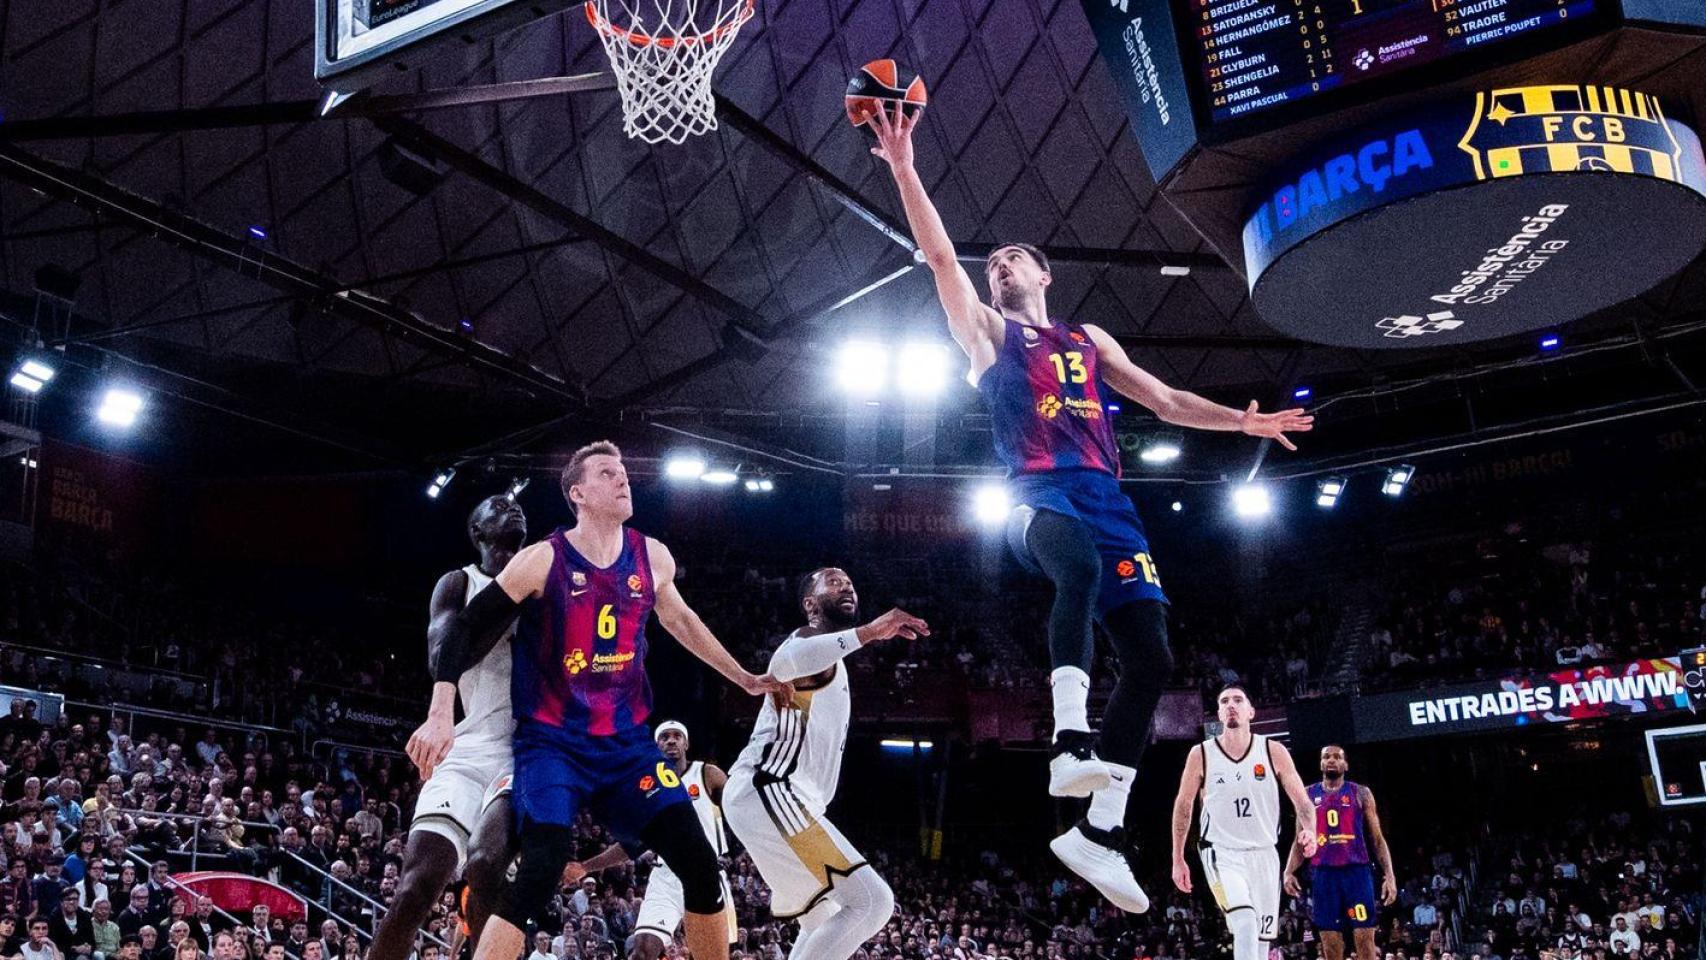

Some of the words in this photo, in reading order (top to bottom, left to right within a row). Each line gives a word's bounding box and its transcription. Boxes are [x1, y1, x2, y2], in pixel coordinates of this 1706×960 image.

[1213, 4, 1276, 33] SATORANSKY
[1215, 14, 1292, 46] HERNANGÓMEZ
[1297, 11, 1304, 20] 2
[1314, 5, 1321, 14] 4
[1462, 11, 1507, 33] TRAORE
[1465, 28, 1504, 46] PIERRIC
[1504, 16, 1542, 35] POUPET
[1559, 8, 1568, 18] 0
[1218, 46, 1243, 60] FALL
[1300, 25, 1308, 35] 0
[1316, 20, 1325, 30] 0
[1220, 53, 1267, 75] CLYBURN
[1303, 40, 1311, 49] 0
[1319, 34, 1328, 44] 5
[1131, 17, 1170, 126] Assistència
[1223, 64, 1280, 89] SHENGELIA
[1306, 54, 1314, 63] 2
[1321, 48, 1332, 59] 11
[1226, 85, 1261, 103] PARRA
[1309, 69, 1316, 78] 1
[1326, 64, 1333, 73] 2
[1229, 101, 1251, 116] XAVI
[1250, 91, 1289, 109] PASCUAL
[1312, 82, 1319, 92] 0
[1542, 116, 1626, 143] FCB
[1274, 129, 1434, 232] BARÇA
[1430, 203, 1570, 304] Assistència
[1463, 240, 1570, 304] Sanitària
[1048, 351, 1088, 384] 13
[597, 604, 617, 640] 6
[1409, 686, 1554, 726] ENTRADES
[656, 762, 680, 788] 6
[1233, 796, 1252, 818] 12
[1326, 809, 1339, 828] 0
[1260, 914, 1274, 935] 12
[1355, 903, 1368, 922] 0
